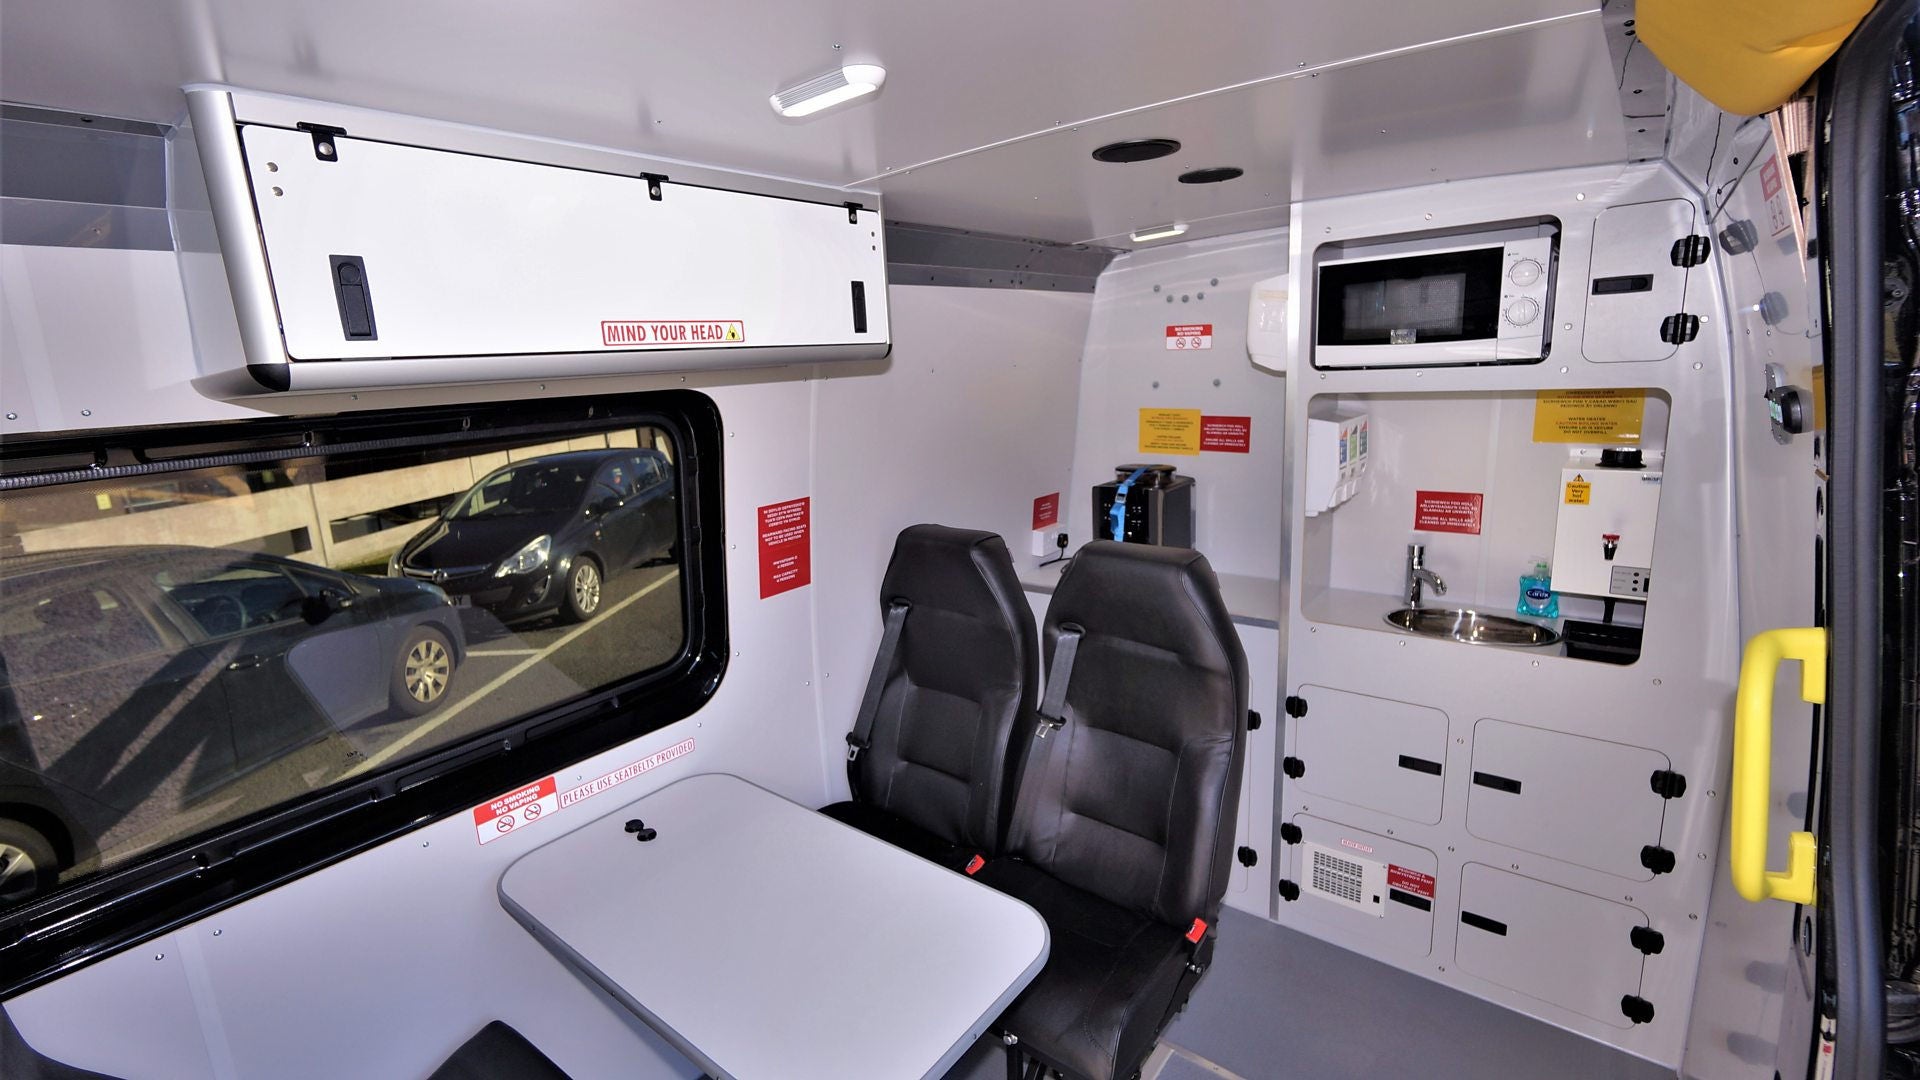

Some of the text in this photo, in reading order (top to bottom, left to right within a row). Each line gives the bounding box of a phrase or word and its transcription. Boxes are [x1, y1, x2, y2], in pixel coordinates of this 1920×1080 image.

[608, 325, 723, 342] MIND YOUR HEAD
[563, 741, 692, 805] PLEASE USE SEATBELTS PROVIDED
[491, 785, 540, 810] NO SMOKING
[496, 794, 537, 815] NO VAPING
